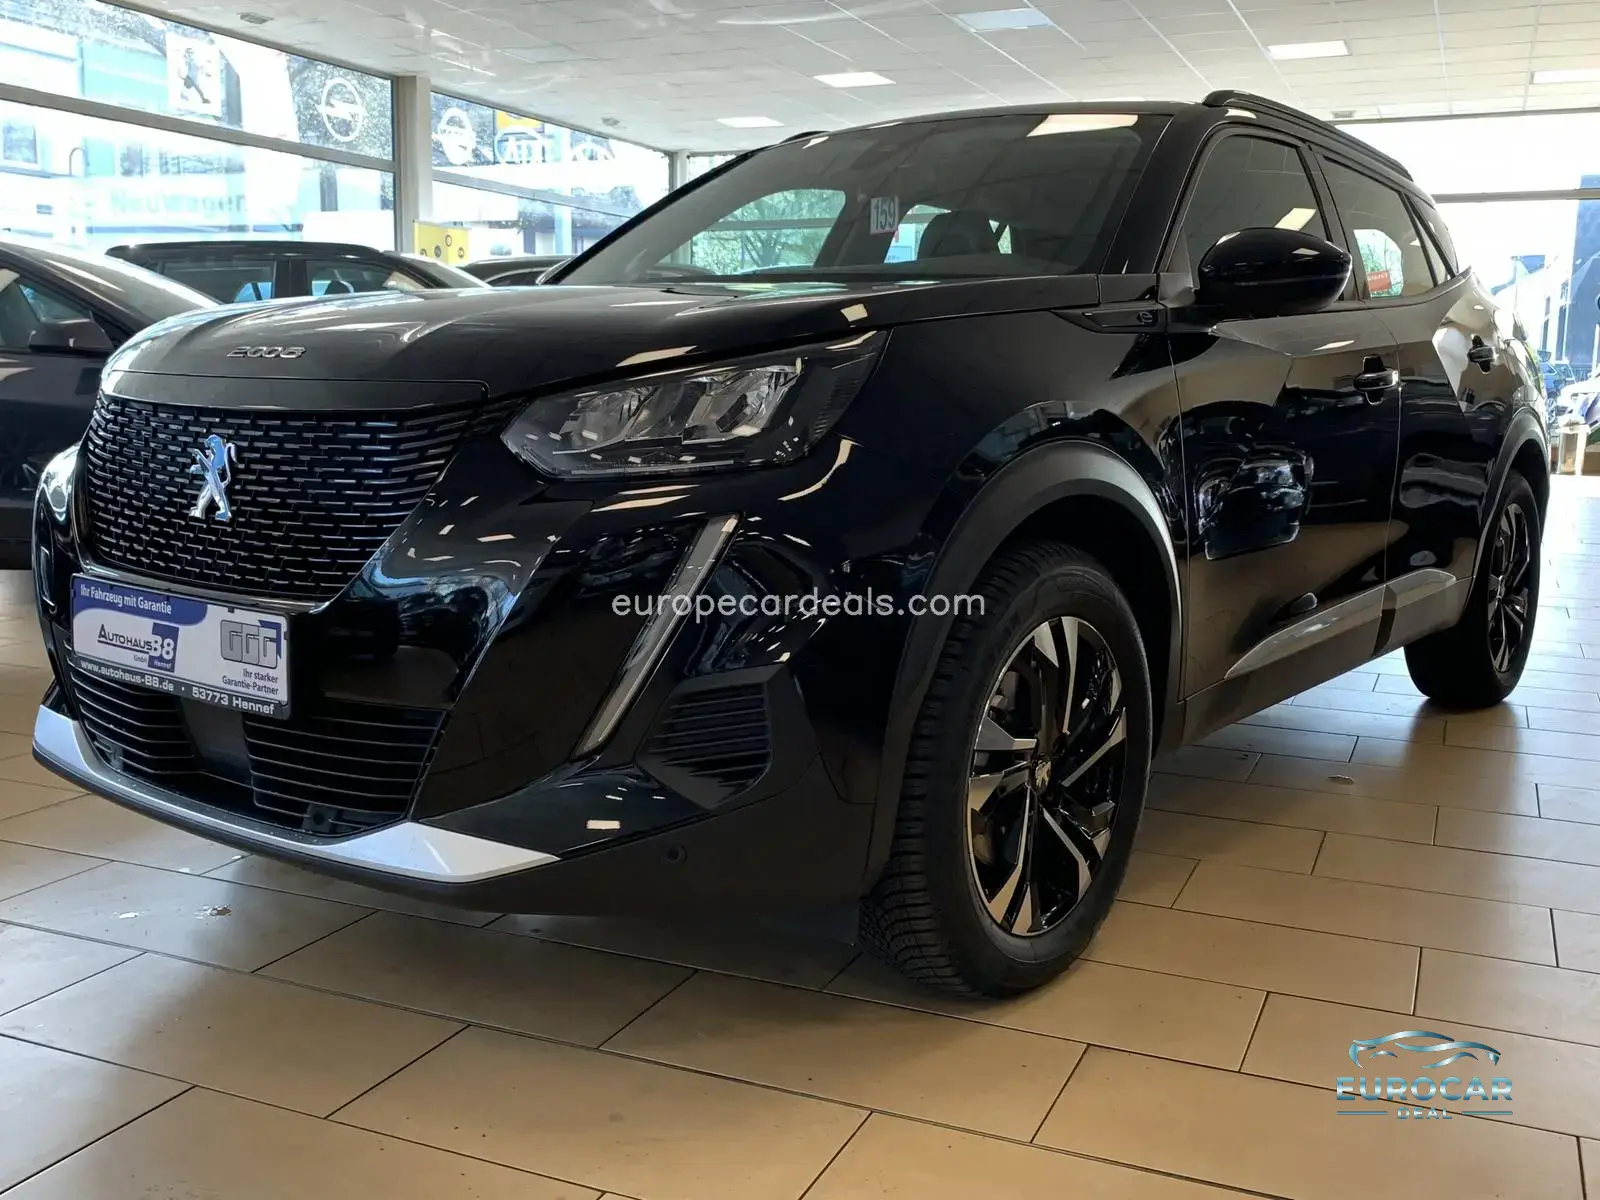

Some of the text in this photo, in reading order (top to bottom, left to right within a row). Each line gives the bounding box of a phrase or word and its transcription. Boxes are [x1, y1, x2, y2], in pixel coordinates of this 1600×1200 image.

[874, 198, 895, 231] 159
[80, 583, 172, 615] Ihr Fahrzeug mit Garantie
[222, 675, 279, 695] Garantie-Partner
[243, 667, 279, 684] Ihr starker
[192, 686, 229, 705] 53773
[232, 696, 275, 715] Hennef
